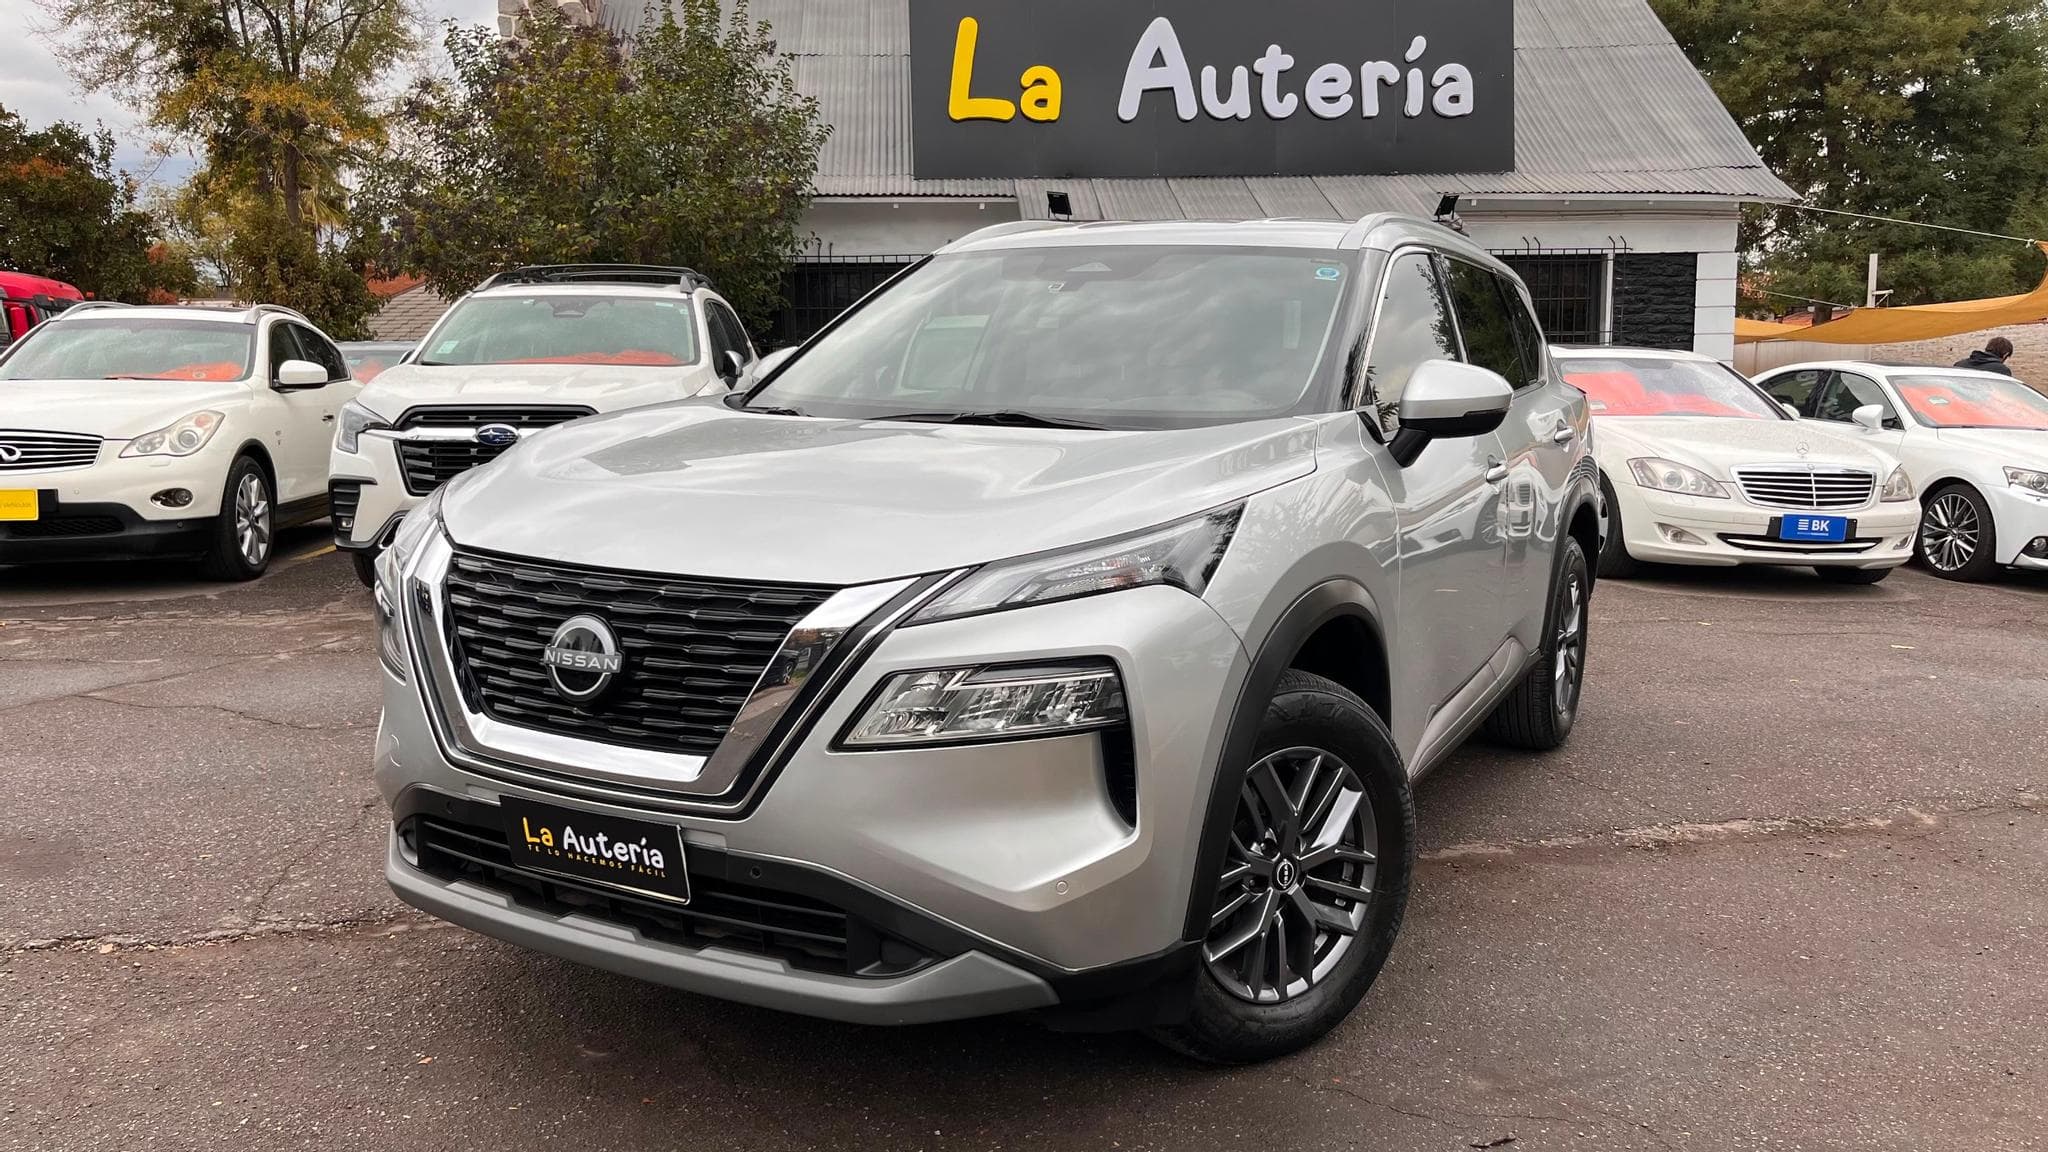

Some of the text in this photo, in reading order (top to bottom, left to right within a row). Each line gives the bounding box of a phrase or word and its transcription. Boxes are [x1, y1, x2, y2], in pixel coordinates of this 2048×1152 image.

[948, 16, 1474, 121] La Autería
[1811, 519, 1830, 532] BK
[545, 649, 619, 671] NISSAN
[522, 816, 665, 869] La Autería
[528, 844, 540, 852] TE
[548, 848, 560, 857] LO
[567, 852, 623, 869] HACEMOS
